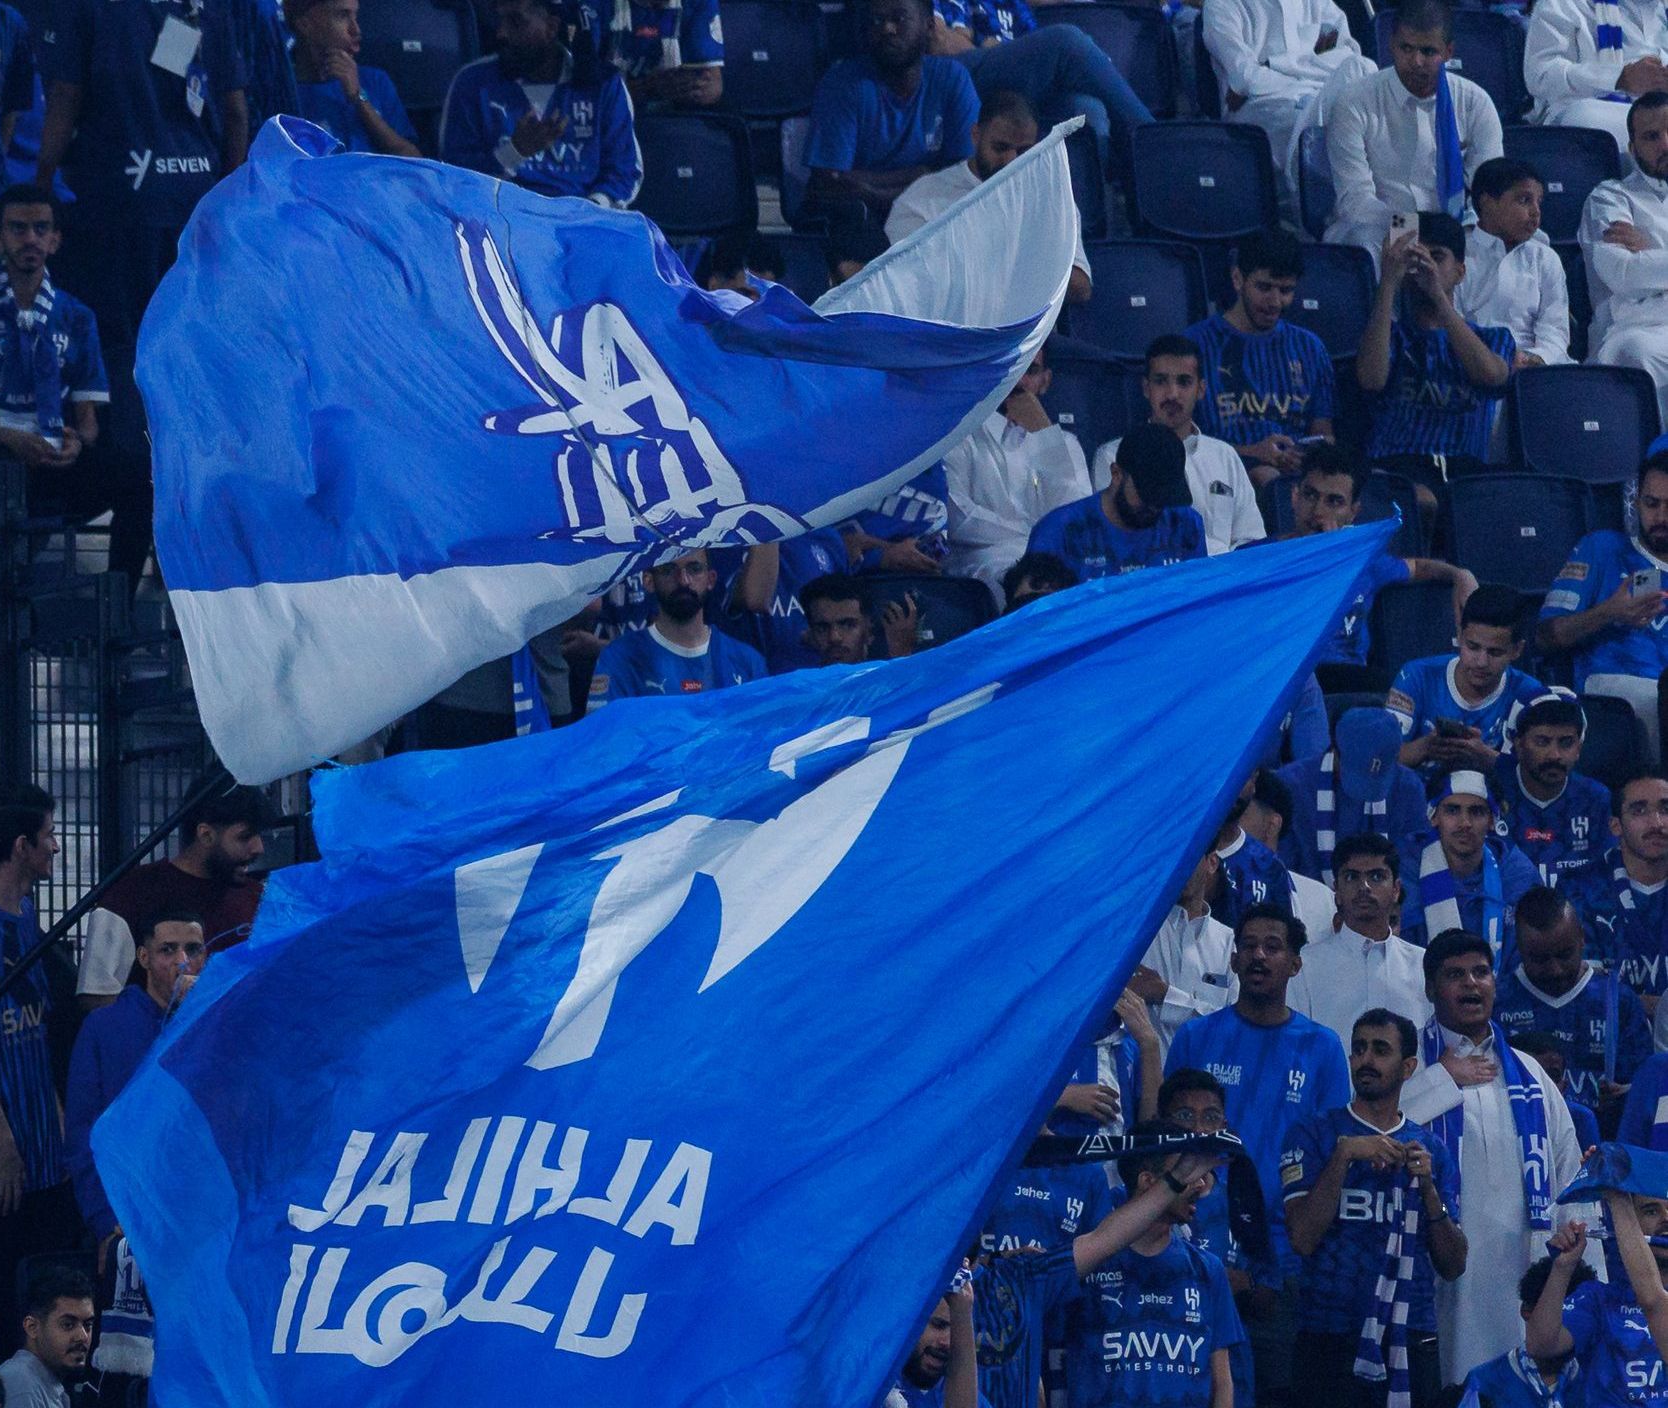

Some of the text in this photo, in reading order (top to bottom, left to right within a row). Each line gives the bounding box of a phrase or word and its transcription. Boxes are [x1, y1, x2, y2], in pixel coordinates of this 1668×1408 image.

[155, 157, 211, 173] SEVEN
[2, 1005, 43, 1036] SAV
[1102, 1331, 1205, 1363] SAVVY
[1104, 1361, 1201, 1375] GAMES GROUP
